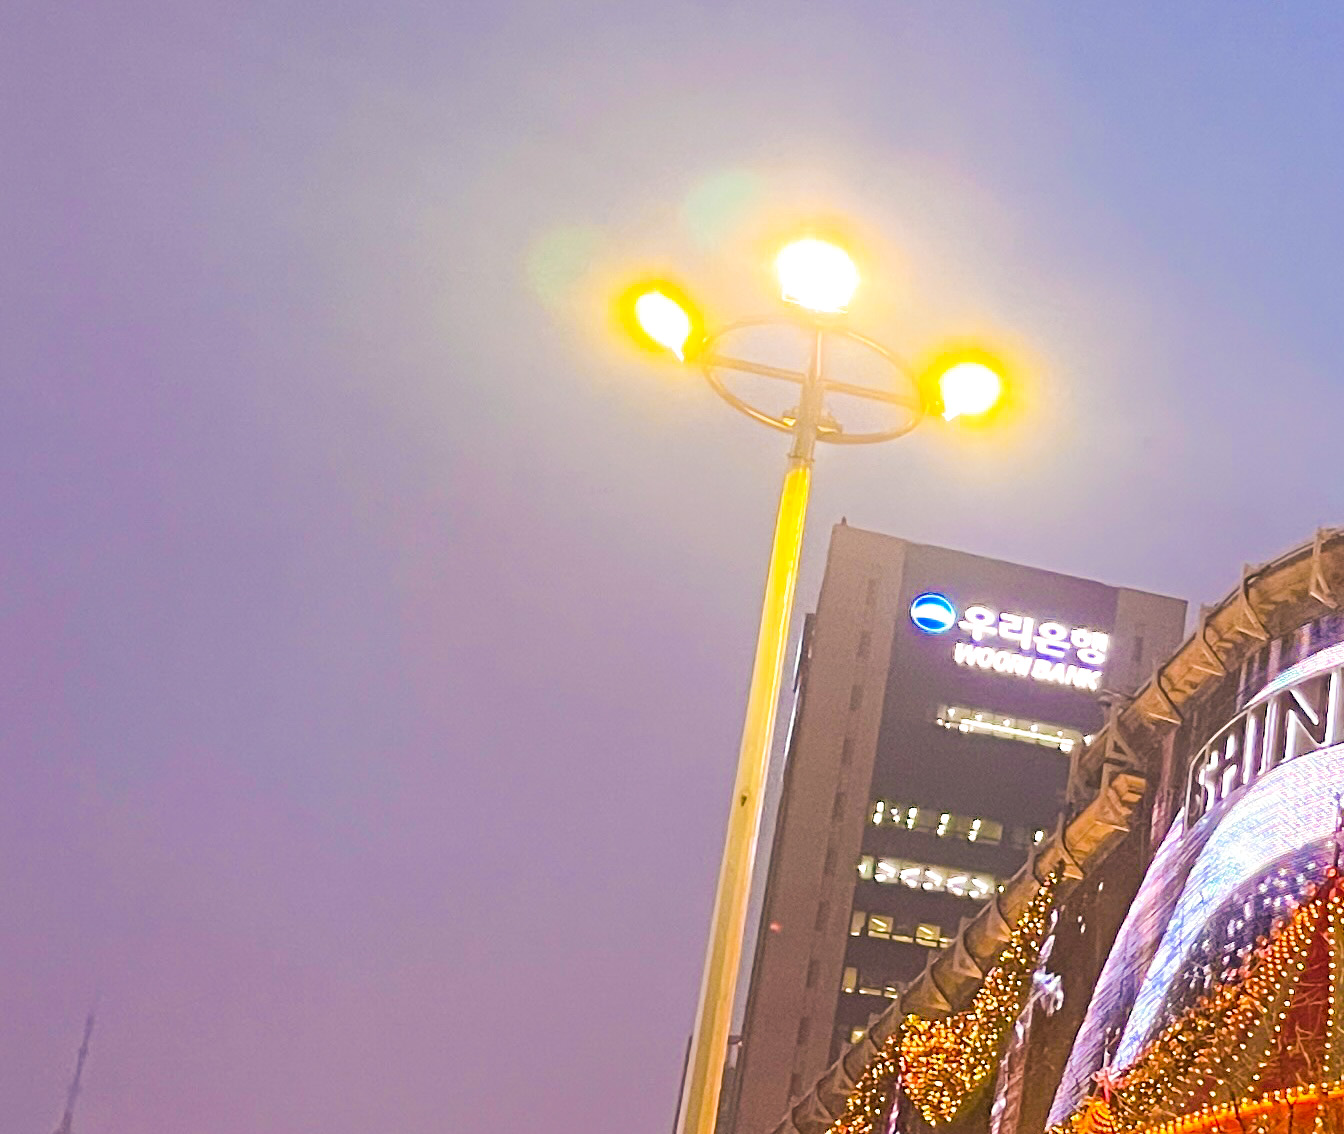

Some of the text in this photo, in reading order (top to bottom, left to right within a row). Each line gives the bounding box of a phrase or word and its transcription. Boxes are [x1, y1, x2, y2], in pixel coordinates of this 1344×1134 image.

[958, 605, 1111, 664] 우리은행
[954, 641, 1103, 691] WOORI BANK
